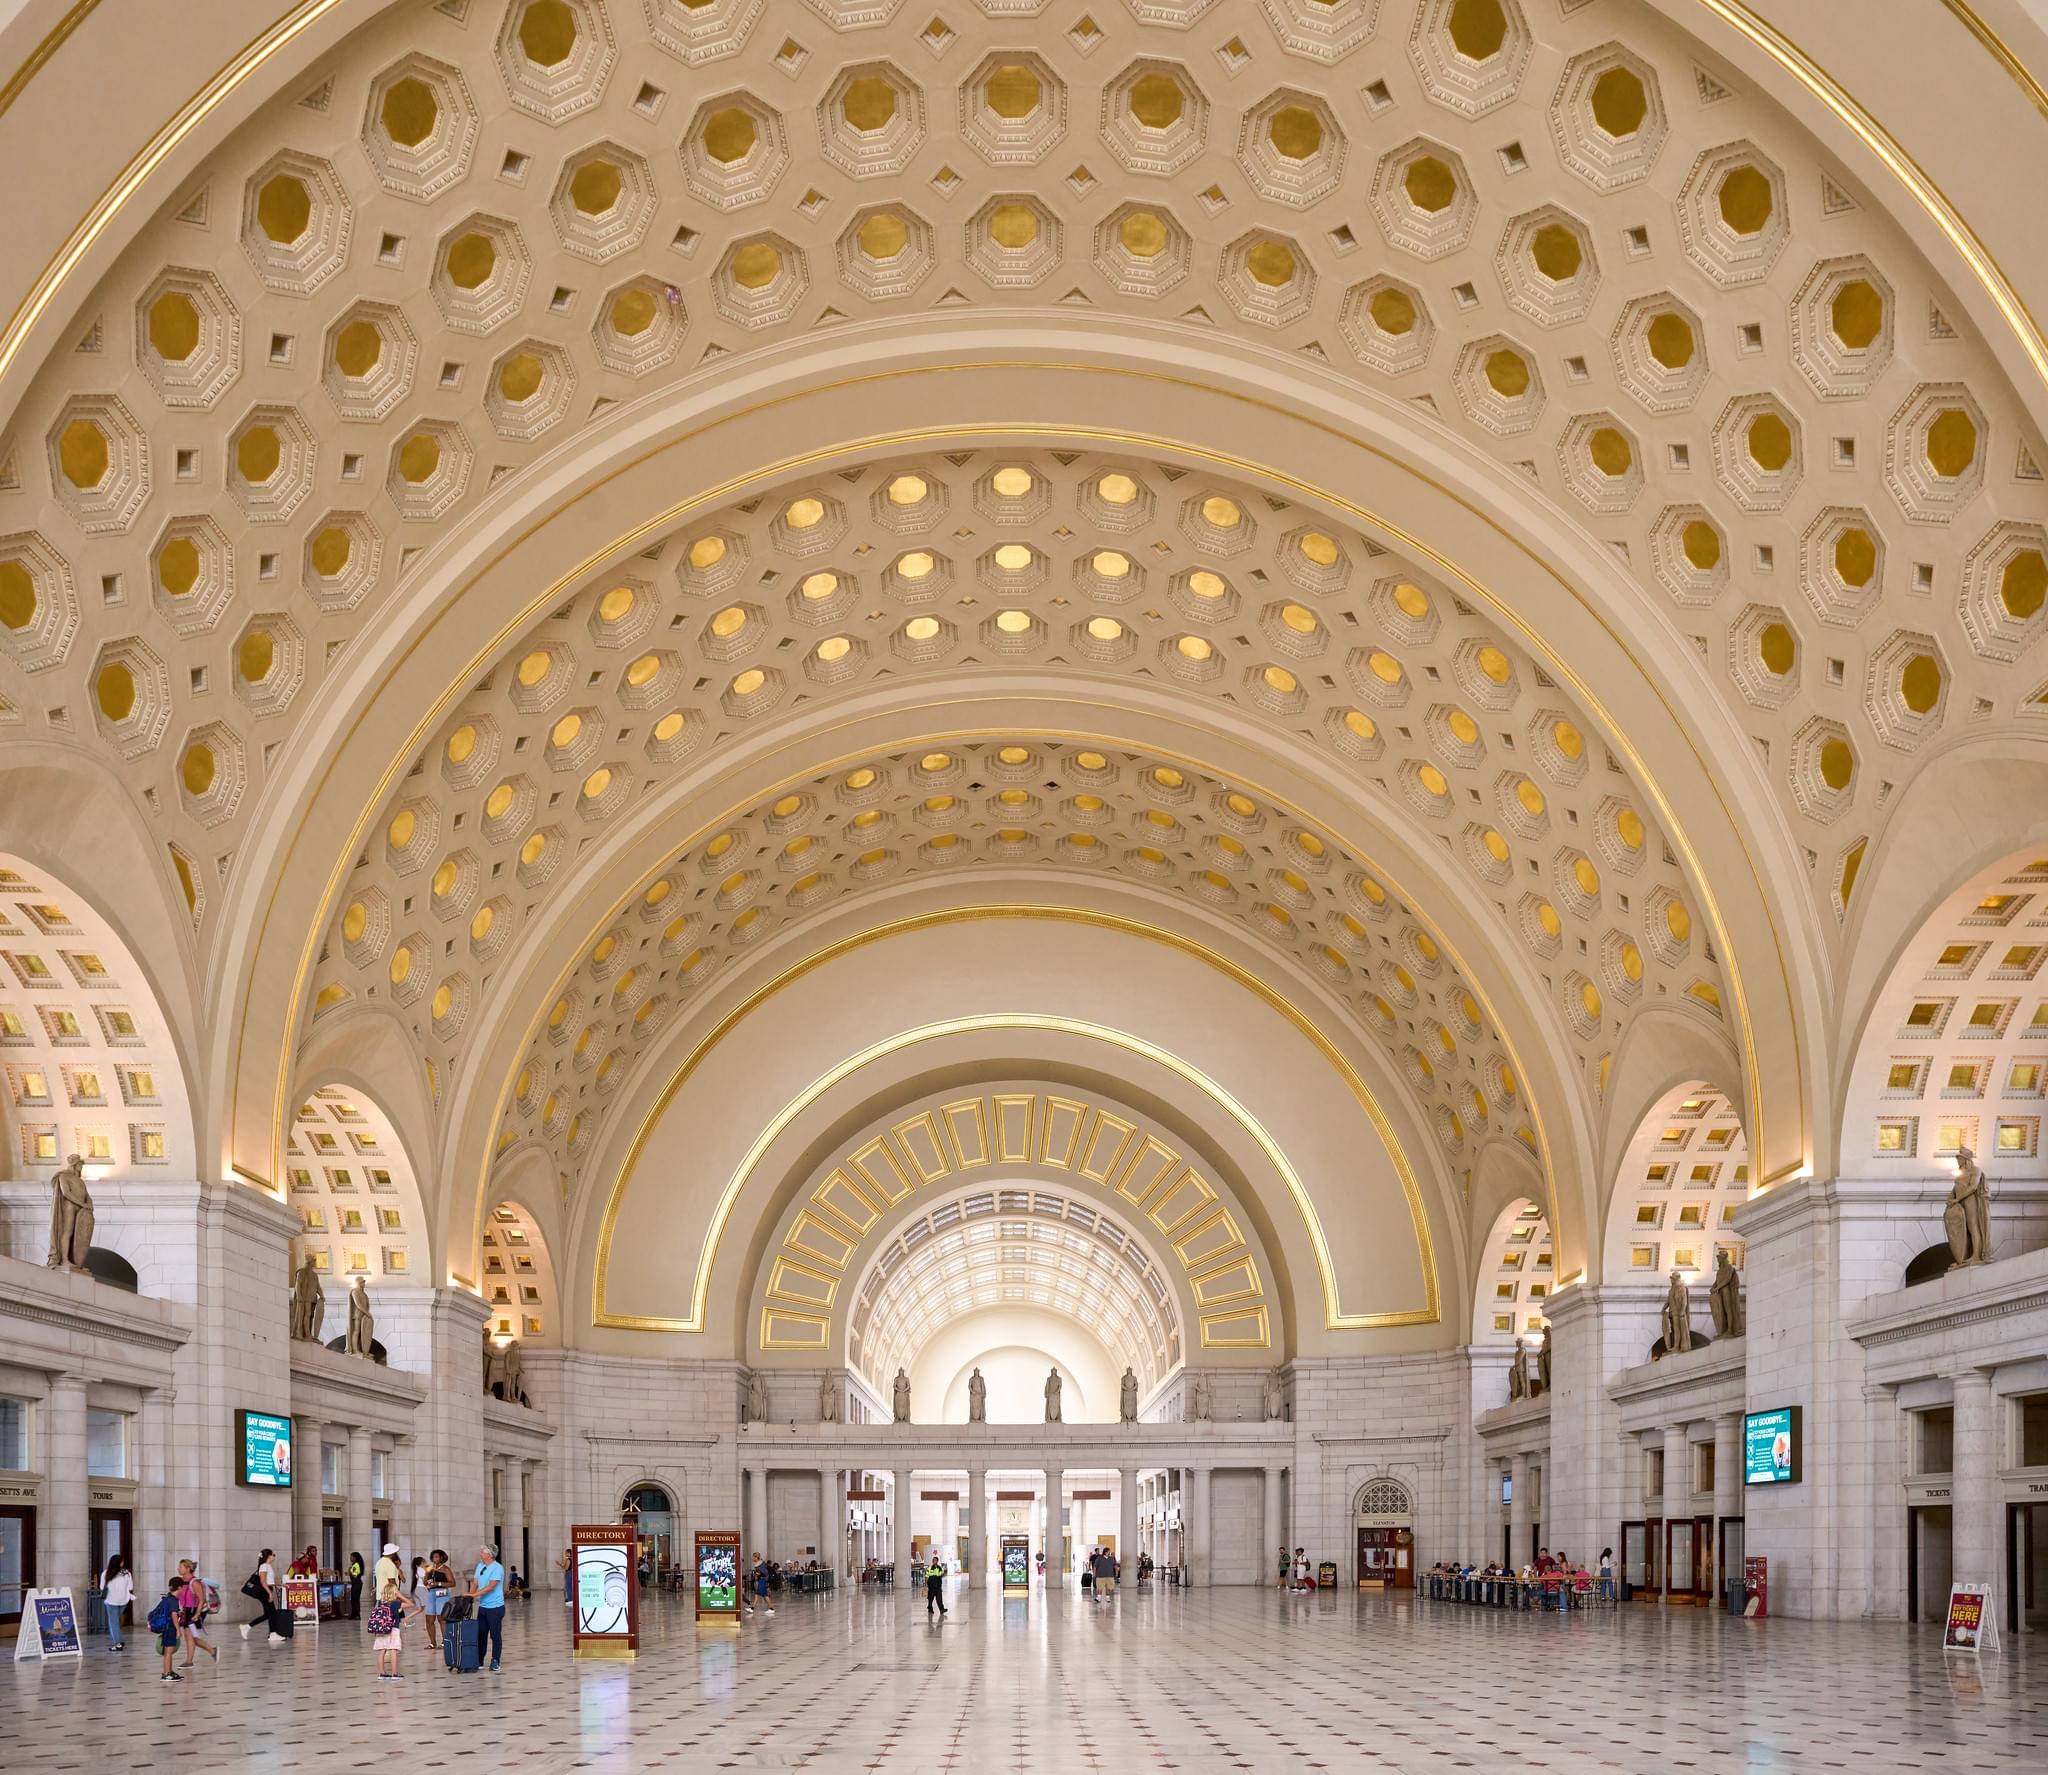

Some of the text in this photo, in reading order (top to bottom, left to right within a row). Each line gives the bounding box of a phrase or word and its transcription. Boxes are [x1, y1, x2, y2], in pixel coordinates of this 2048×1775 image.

[247, 1416, 258, 1426] SAY
[1748, 1419, 1758, 1428] SAY
[92, 1492, 113, 1500] TOURS
[577, 1531, 627, 1539] DIRECTORY
[288, 1594, 313, 1603] HERE
[1951, 1610, 1979, 1622] HERE
